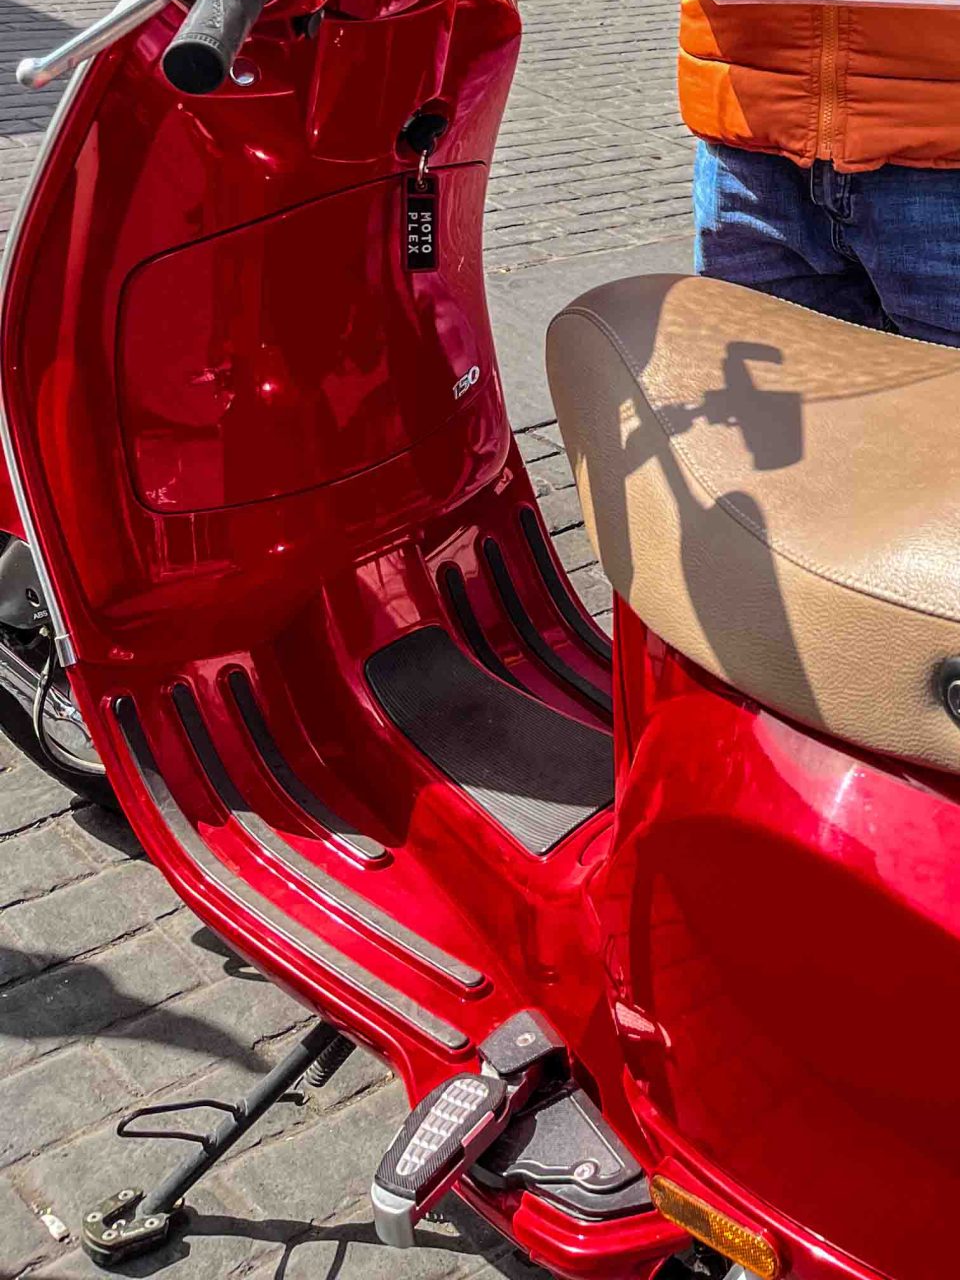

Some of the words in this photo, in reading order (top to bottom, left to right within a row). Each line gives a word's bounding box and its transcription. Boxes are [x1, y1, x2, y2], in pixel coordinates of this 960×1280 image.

[408, 212, 419, 254] PLEX
[420, 212, 432, 253] MOTO
[452, 365, 480, 400] 150
[33, 610, 49, 620] ABS
